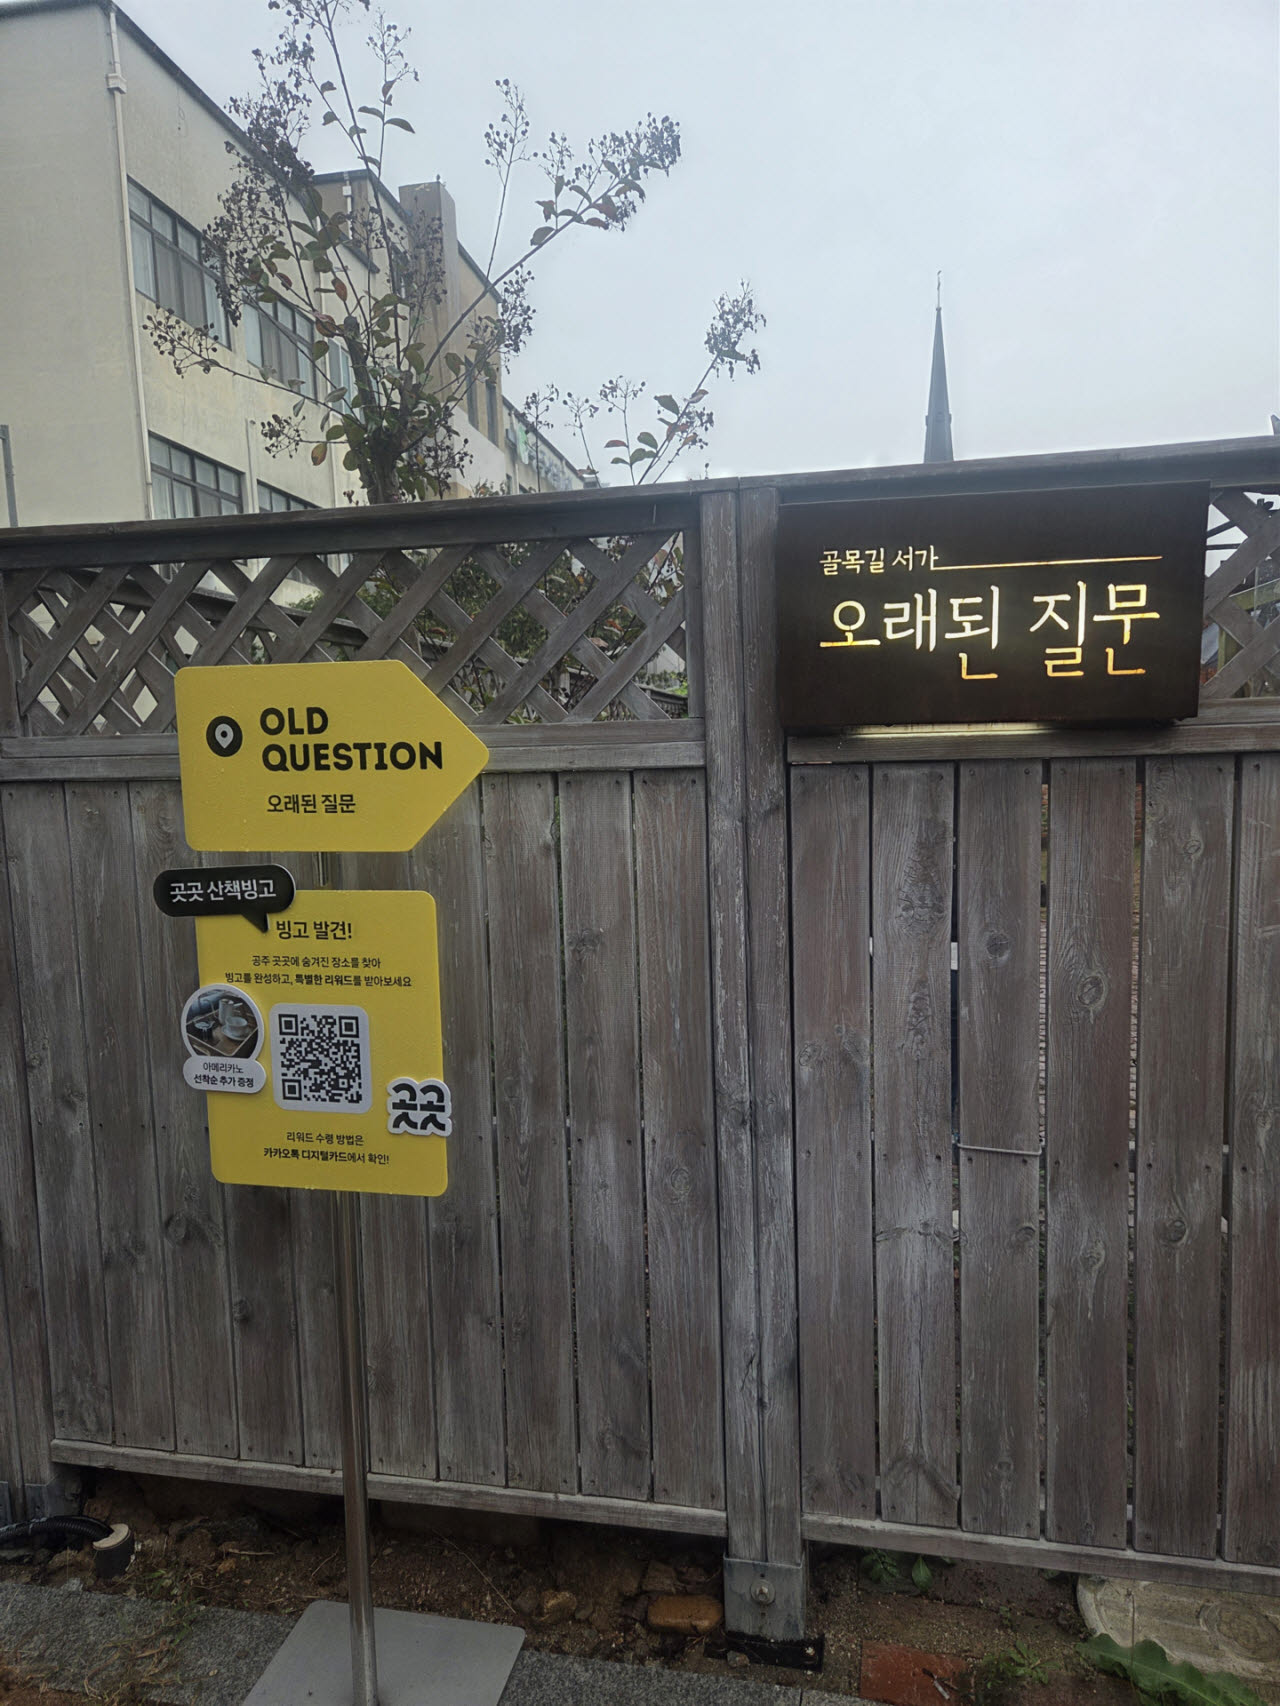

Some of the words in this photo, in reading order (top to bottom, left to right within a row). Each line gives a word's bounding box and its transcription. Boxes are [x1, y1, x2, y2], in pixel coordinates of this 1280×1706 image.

[820, 547, 885, 575] 골목길
[892, 545, 939, 571] 서가
[820, 585, 999, 679] 오래된
[1030, 580, 1161, 677] 질문
[260, 707, 329, 735] OLD
[262, 742, 443, 772] QUESTION
[267, 794, 317, 814] 오래된
[321, 794, 356, 814] 질문
[170, 882, 203, 902] 곳곳
[206, 880, 276, 901] 산책빙고
[276, 922, 309, 939] 빙고
[313, 922, 352, 940] 발견!
[252, 955, 269, 967] 공주
[272, 956, 300, 968] 곳곳에
[301, 956, 329, 968] 숨겨진
[331, 956, 360, 968] 장소를
[362, 957, 381, 969] 찾아
[225, 972, 252, 984] 빙고를
[254, 973, 293, 986] 완성하고,
[294, 974, 322, 986] 특별한
[324, 975, 362, 986] 리워드를
[364, 976, 411, 987] 받아보세요
[203, 1062, 244, 1074] 아메리카노
[194, 1074, 218, 1086] 선착순
[219, 1075, 236, 1087] 추가
[238, 1077, 254, 1088] 증정
[286, 1132, 314, 1143] 리워드
[315, 1133, 334, 1144] 수령
[336, 1134, 363, 1146] 방법은
[264, 1148, 300, 1159] 카카오톡
[368, 1152, 390, 1164] 확인!
